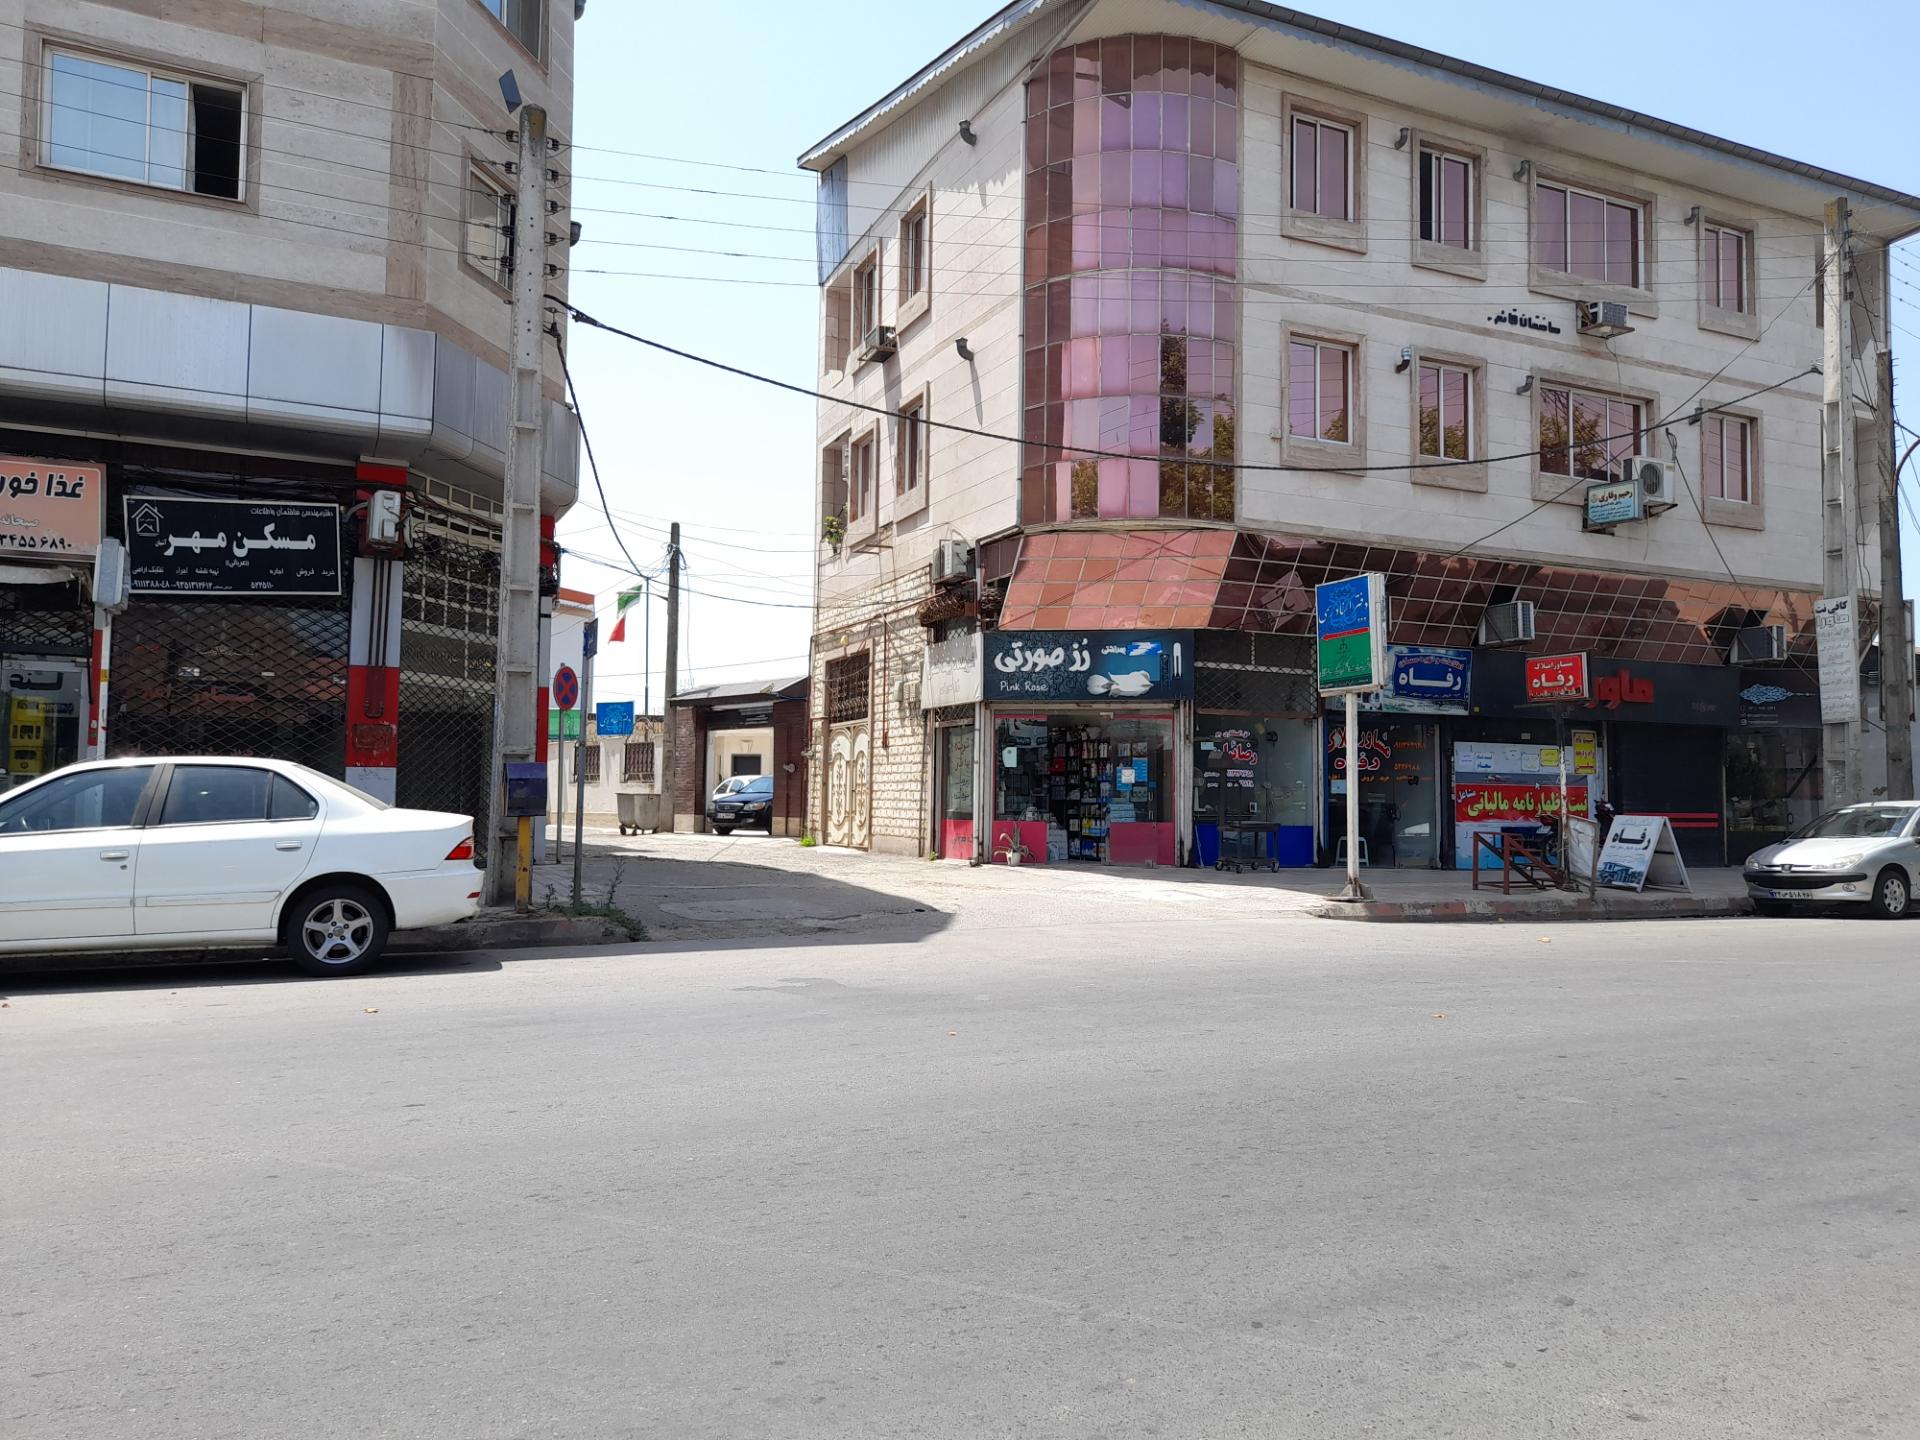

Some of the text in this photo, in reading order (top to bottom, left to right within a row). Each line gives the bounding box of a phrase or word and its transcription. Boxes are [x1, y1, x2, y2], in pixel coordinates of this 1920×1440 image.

[45, 471, 86, 499] غذا
[164, 523, 316, 557] مسکن مهر
[1815, 600, 1848, 614] کافی نت
[994, 640, 1065, 673] صورتی
[1000, 681, 1049, 692] Pink Rose
[1399, 667, 1462, 691] رفاه
[1532, 670, 1575, 688] رفاه
[1583, 668, 1655, 710] ماور
[1334, 751, 1381, 770] رفه
[1467, 791, 1509, 817] مالیاتی
[1611, 827, 1651, 850] رفاه
